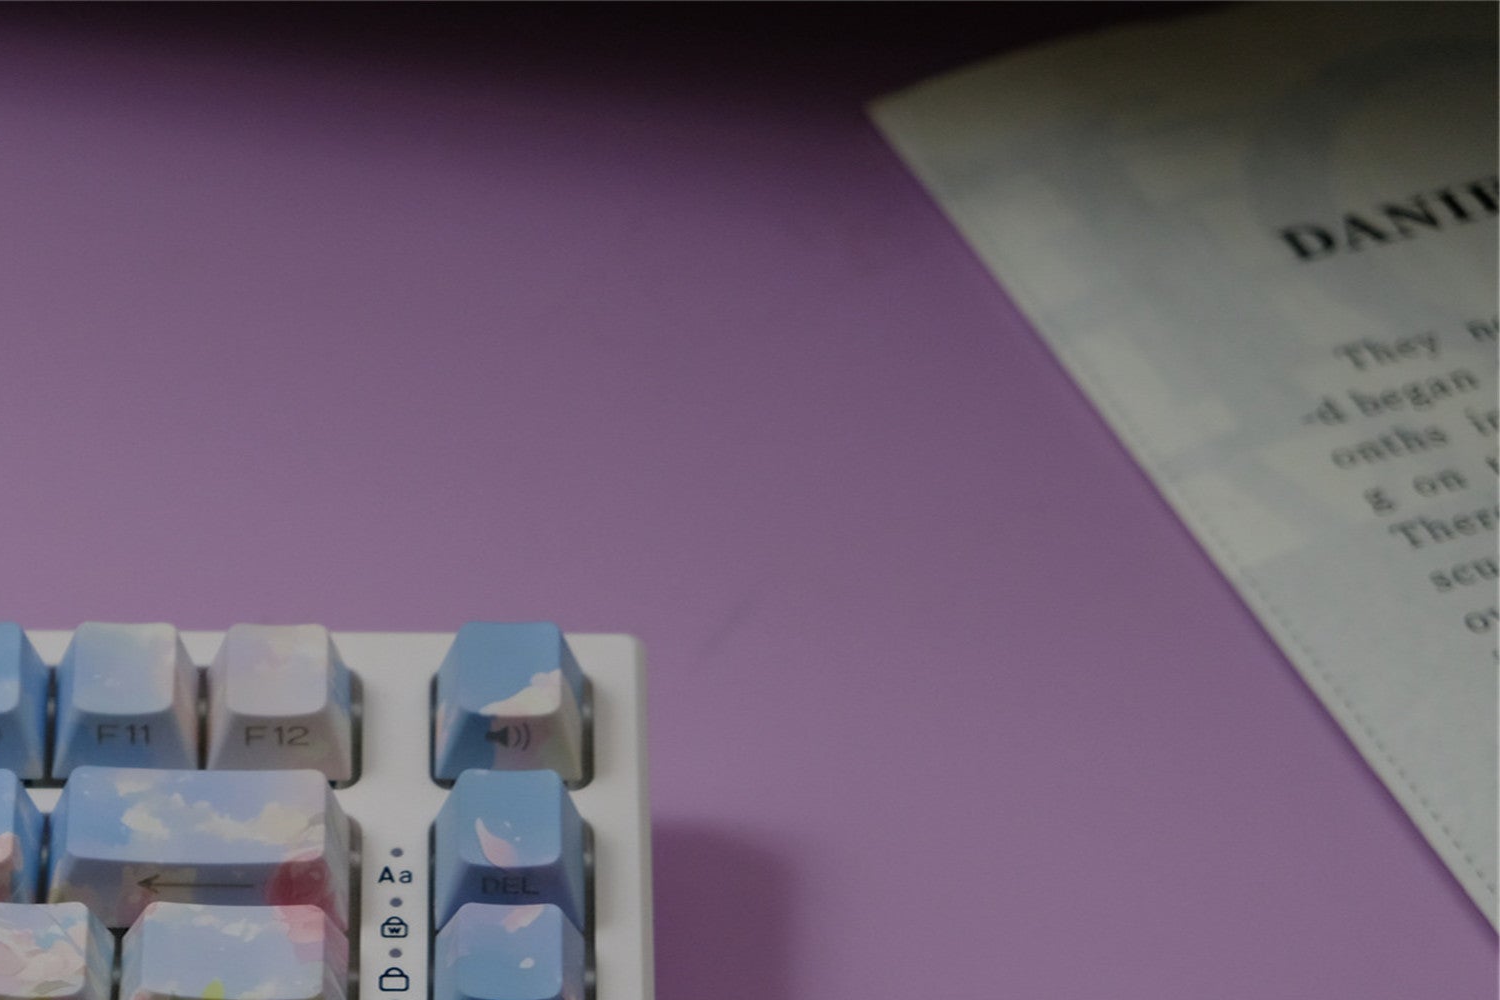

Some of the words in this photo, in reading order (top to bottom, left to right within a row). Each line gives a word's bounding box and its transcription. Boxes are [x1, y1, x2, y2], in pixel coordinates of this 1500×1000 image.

[1332, 330, 1439, 371] They
[1347, 369, 1480, 411] began
[1412, 469, 1468, 498] on
[1388, 506, 1500, 548] Ther
[98, 724, 150, 745] F11
[244, 726, 310, 747] F12
[378, 866, 412, 884] Aa
[482, 876, 539, 895] DEL
